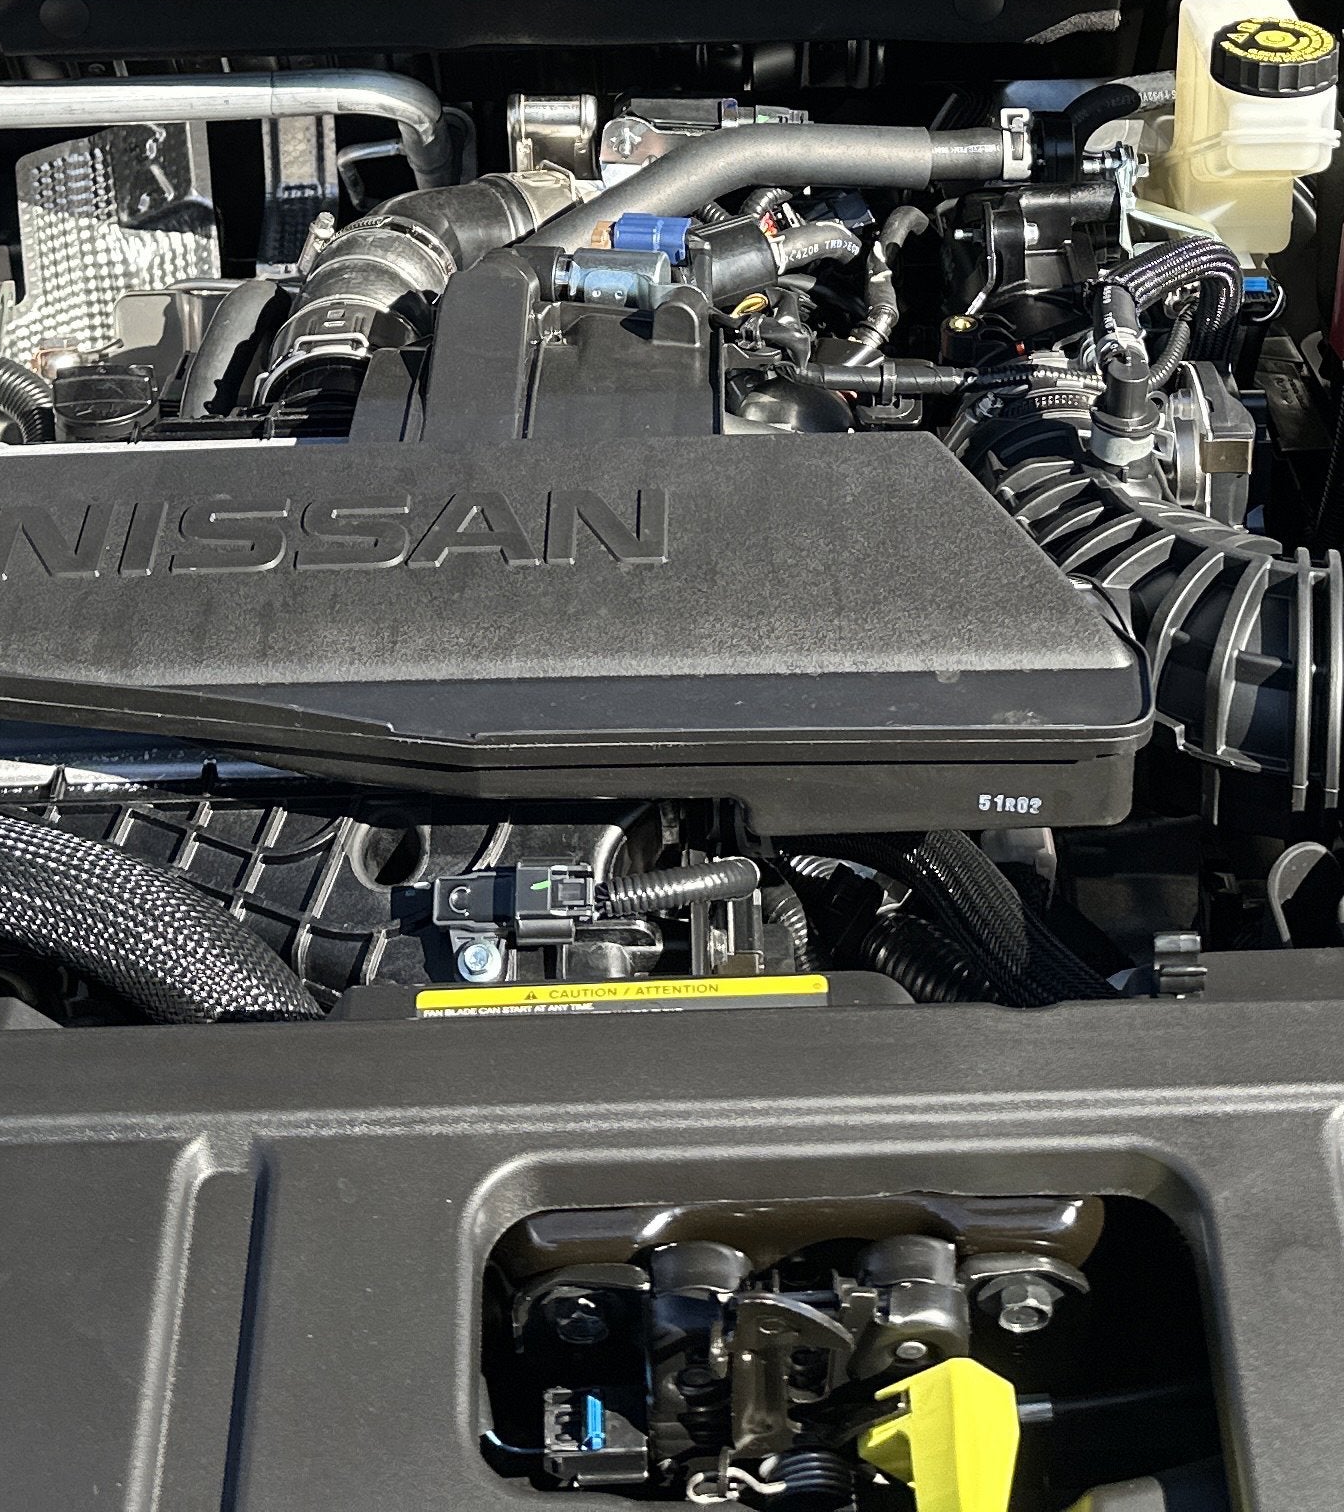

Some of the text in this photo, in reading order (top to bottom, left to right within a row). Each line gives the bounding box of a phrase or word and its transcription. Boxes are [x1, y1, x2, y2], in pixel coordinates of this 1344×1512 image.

[548, 987, 618, 1000] CAUTION
[635, 983, 719, 996] ATTENTION
[423, 1009, 443, 1018] FAN
[444, 1007, 478, 1017] BLADE
[478, 1006, 501, 1016] CAN
[501, 1005, 533, 1015] START
[534, 1004, 547, 1013] AT
[548, 1003, 570, 1012] ANY
